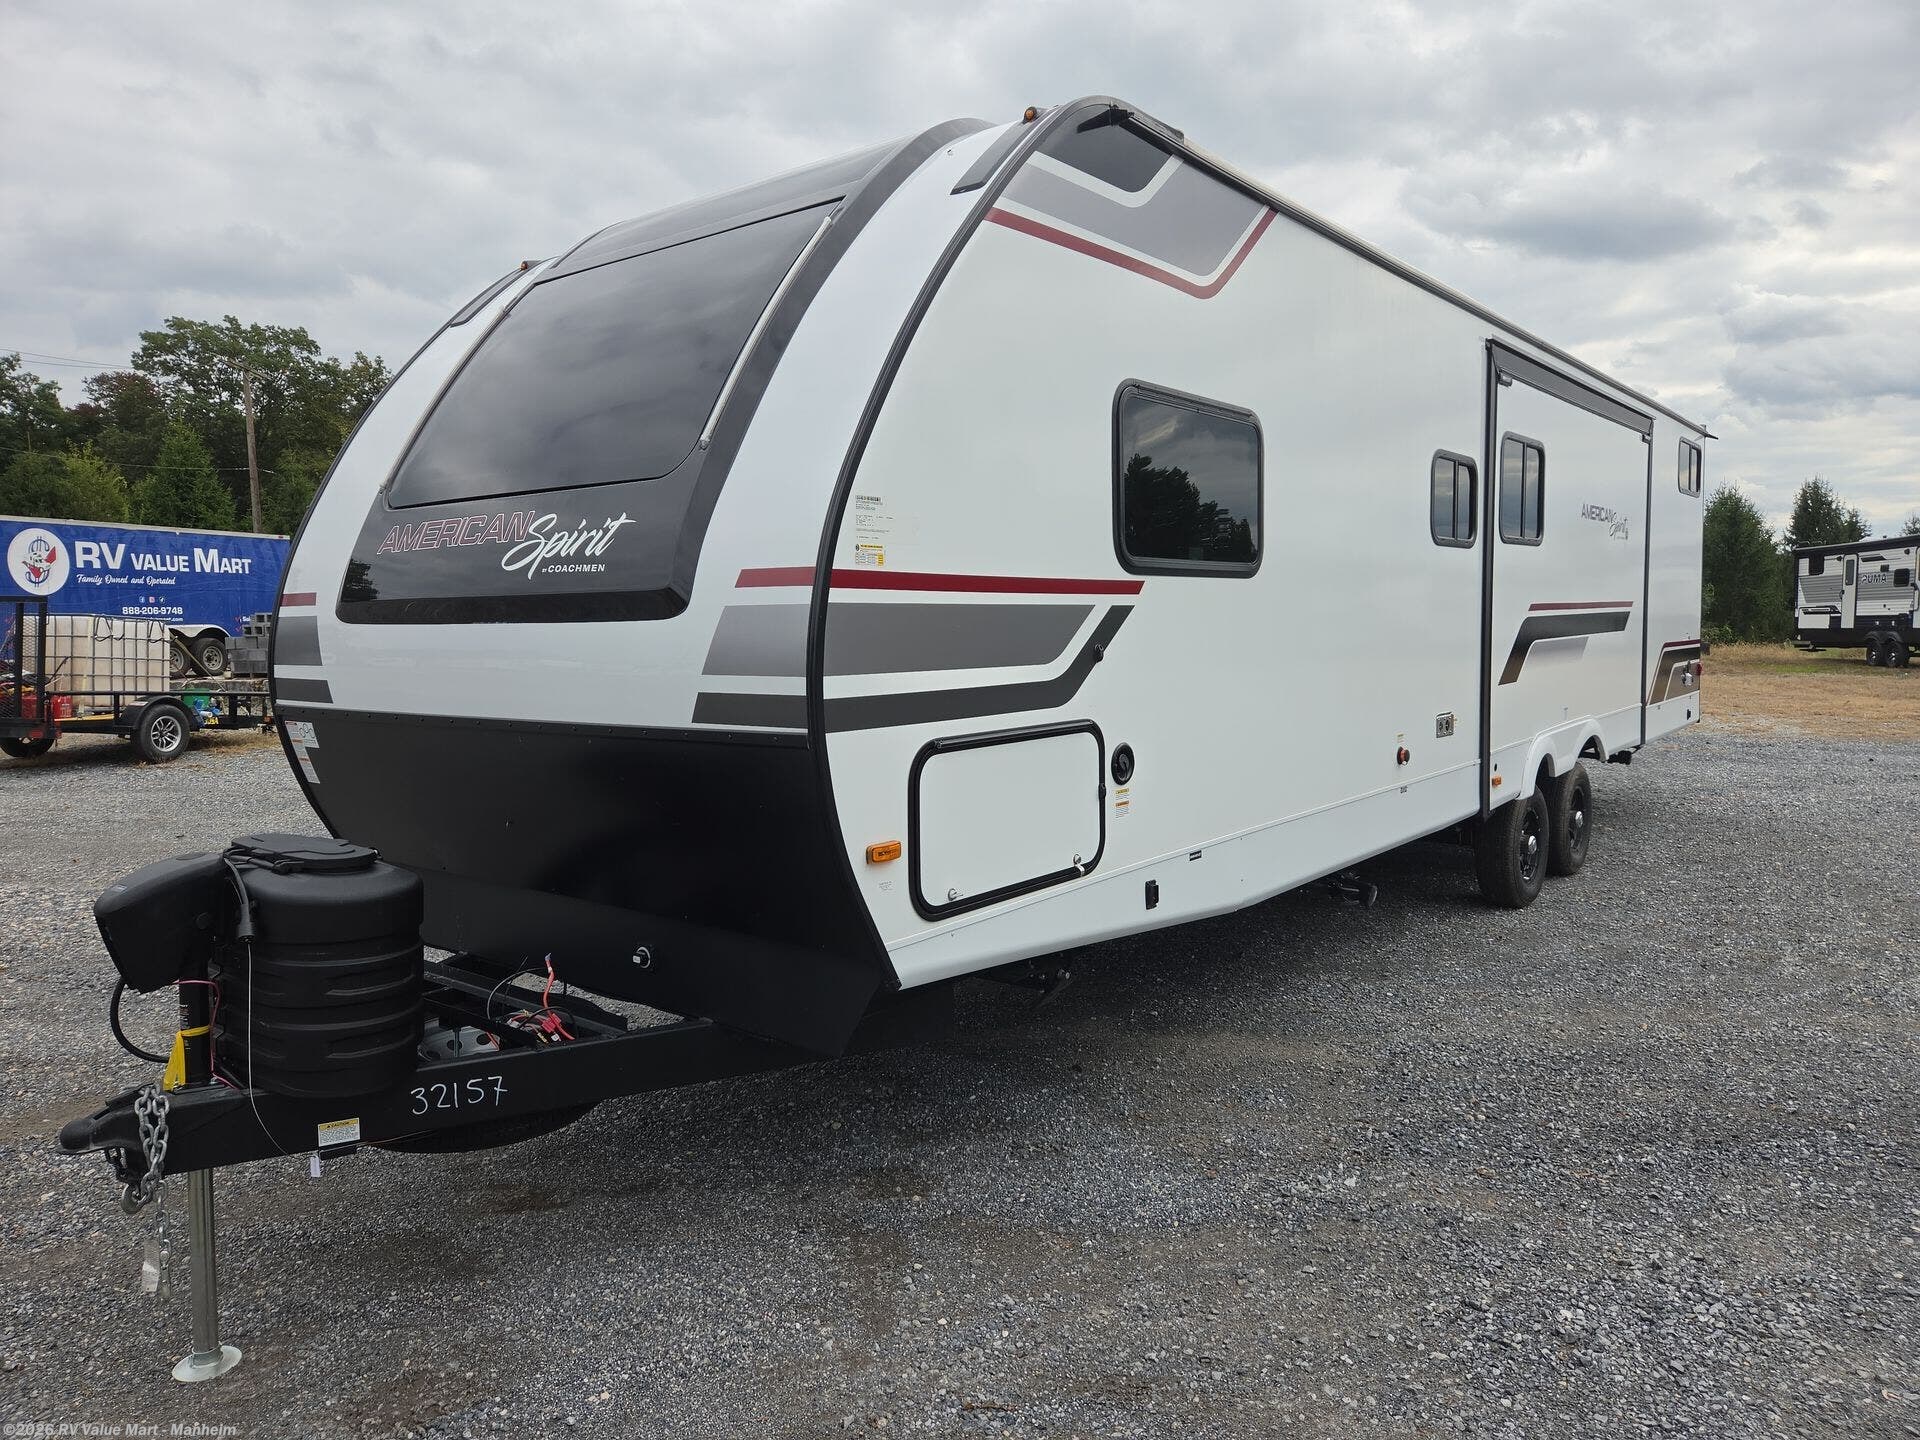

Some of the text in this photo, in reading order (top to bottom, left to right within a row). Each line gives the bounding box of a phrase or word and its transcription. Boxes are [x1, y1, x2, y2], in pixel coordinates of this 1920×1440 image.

[377, 510, 637, 580] AMERICAN Spirit
[75, 541, 125, 570] RV
[131, 553, 190, 572] VALUE
[548, 564, 605, 573] COACHMEN
[76, 574, 176, 586] Family Owned and Operated
[1860, 573, 1887, 584] PUMA
[122, 606, 183, 615] 888-206-9748
[410, 1076, 508, 1115] 32157
